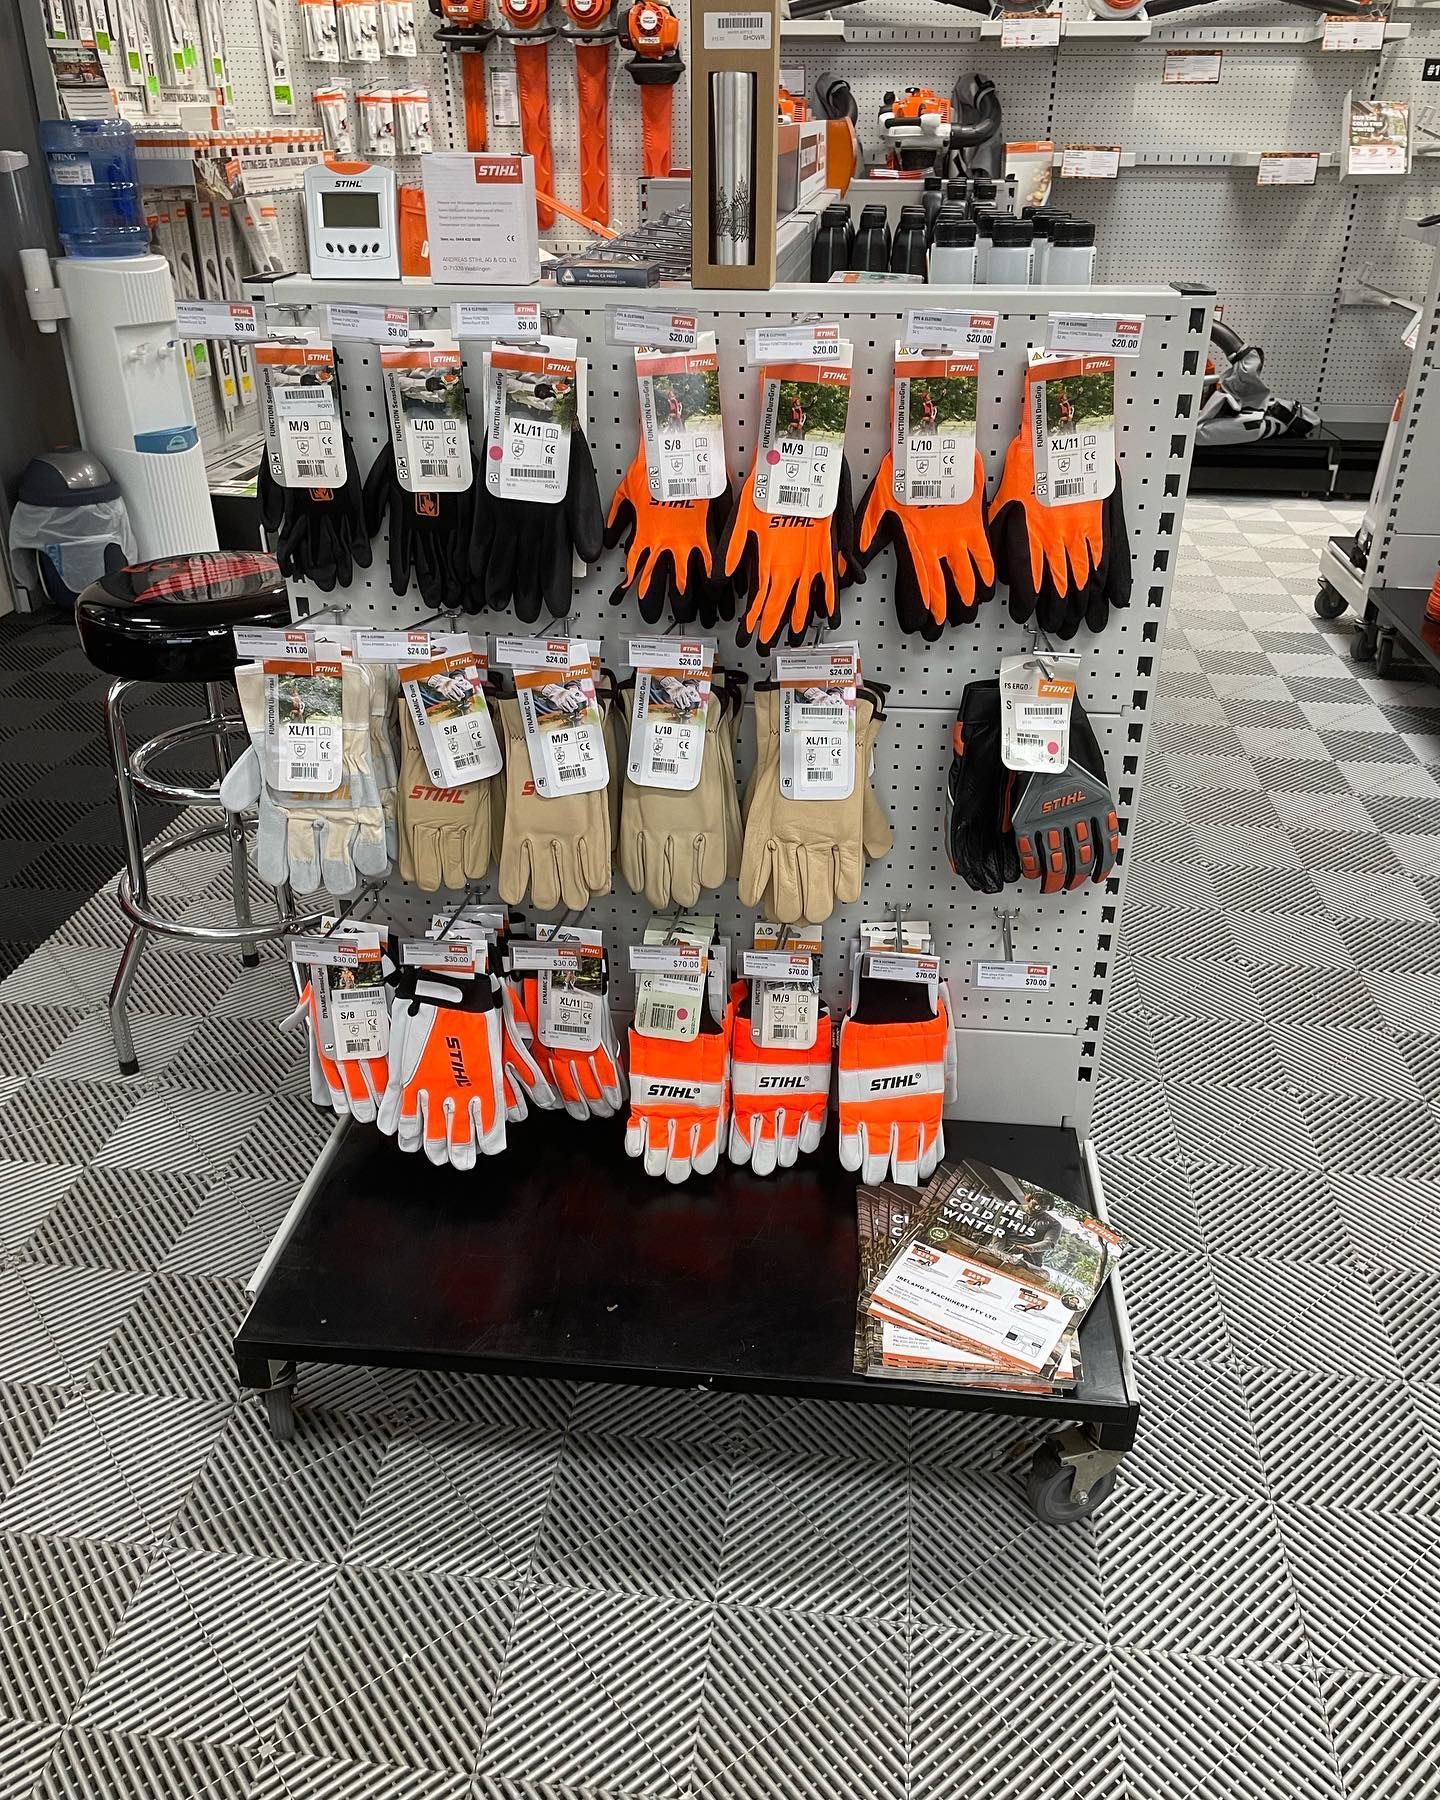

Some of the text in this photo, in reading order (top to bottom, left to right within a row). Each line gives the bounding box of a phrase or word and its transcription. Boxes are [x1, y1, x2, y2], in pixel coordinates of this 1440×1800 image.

[478, 165, 519, 176] STIHL
[334, 180, 362, 188] STIHL
[234, 322, 255, 332] $9.00
[518, 322, 538, 330] $9.00
[388, 328, 408, 338] $9.00
[668, 332, 694, 344] $20.00
[966, 334, 992, 344] $20.00
[1112, 338, 1138, 348] $20.00
[812, 346, 838, 354] $20.00
[306, 353, 331, 361] STIHL
[432, 355, 457, 363] STIHL
[546, 362, 573, 373] STIHL
[689, 358, 714, 368] STIHL
[948, 364, 976, 372] STIHL
[1084, 360, 1111, 370] STIHL
[822, 370, 848, 381] STIHL
[268, 405, 276, 437] FUNCTION
[288, 420, 310, 432] M/9
[392, 408, 402, 442] FUNCTION
[414, 420, 434, 431] L/10
[492, 405, 501, 440] FUNCTION
[514, 422, 542, 437] XL/11
[763, 412, 772, 448] FUNCTION
[1036, 414, 1044, 448] FUNCTION
[664, 440, 681, 451] S/8
[782, 442, 804, 456] M/9
[911, 440, 932, 452] L/10
[1052, 438, 1078, 451] XL/11
[769, 516, 815, 528] STIHL
[286, 646, 308, 654] $11.00
[449, 658, 472, 667] STIHL
[546, 656, 568, 664] $24.00
[678, 658, 702, 666] $24.00
[314, 664, 340, 673] STIHL
[565, 668, 589, 678] STIHL
[830, 668, 852, 676] $24.00
[1004, 682, 1012, 690] FS
[1041, 684, 1071, 694] STIHL
[638, 690, 646, 718] DYNAMIC
[1006, 700, 1012, 710] S
[410, 700, 424, 726] DYNAMIC
[525, 705, 535, 734] DYNAMIC
[288, 726, 314, 736] XL/11
[444, 724, 458, 736] S/8
[654, 725, 672, 735] L/10
[551, 733, 569, 744] M/9
[806, 736, 828, 746] XL/11
[409, 785, 465, 804] STIHL
[1042, 790, 1086, 814] STIHL
[333, 956, 357, 964] $30.00
[673, 960, 698, 968] $70.00
[788, 968, 808, 976] $70.00
[916, 972, 936, 980] $70.00
[1026, 978, 1047, 986] $70.00
[560, 996, 580, 1008] XL/11
[772, 994, 790, 1003] M/9
[340, 1012, 355, 1020] S/8
[446, 1036, 472, 1088] STIHL
[956, 1188, 1026, 1220] CUT THE
[943, 1206, 1006, 1239] WINTER
[950, 1199, 1037, 1238] COLD THIS
[1086, 1222, 1116, 1242] STIHL
[896, 1275, 931, 1293] IRELAND'S
[930, 1290, 970, 1310] MACHINERY
[970, 1308, 984, 1317] PTY
[984, 1312, 997, 1322] LTD
